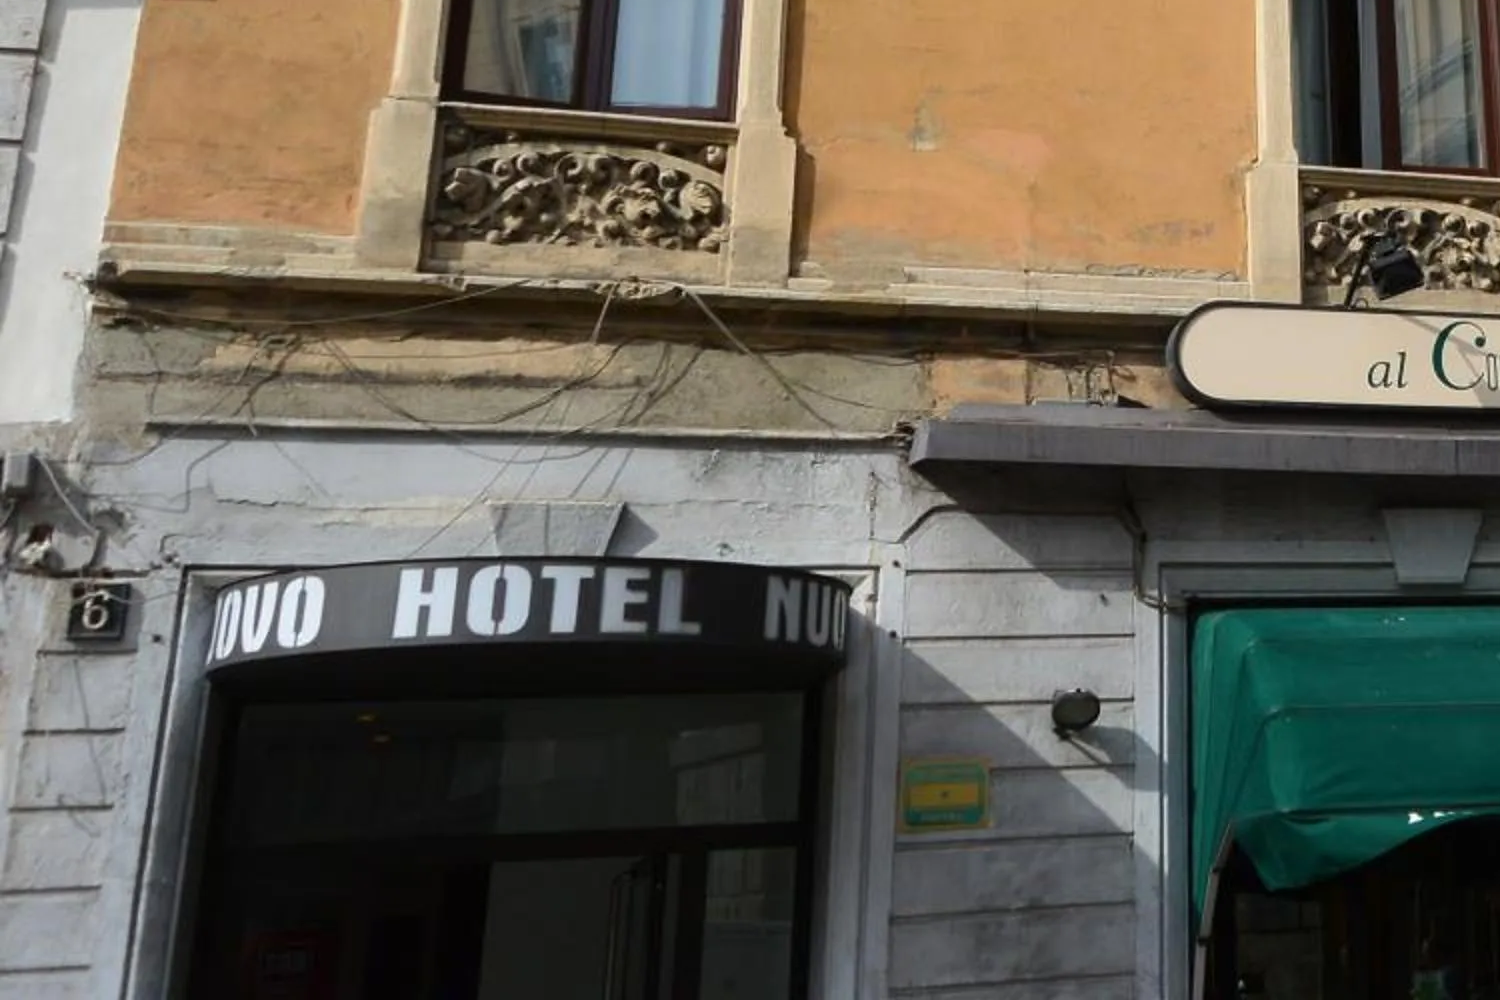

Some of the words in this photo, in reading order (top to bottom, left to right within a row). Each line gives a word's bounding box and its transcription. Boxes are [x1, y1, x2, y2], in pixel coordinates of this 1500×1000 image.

[1366, 351, 1410, 389] al
[82, 589, 109, 630] 6
[205, 575, 326, 666] OVO
[391, 564, 703, 640] HOTEL
